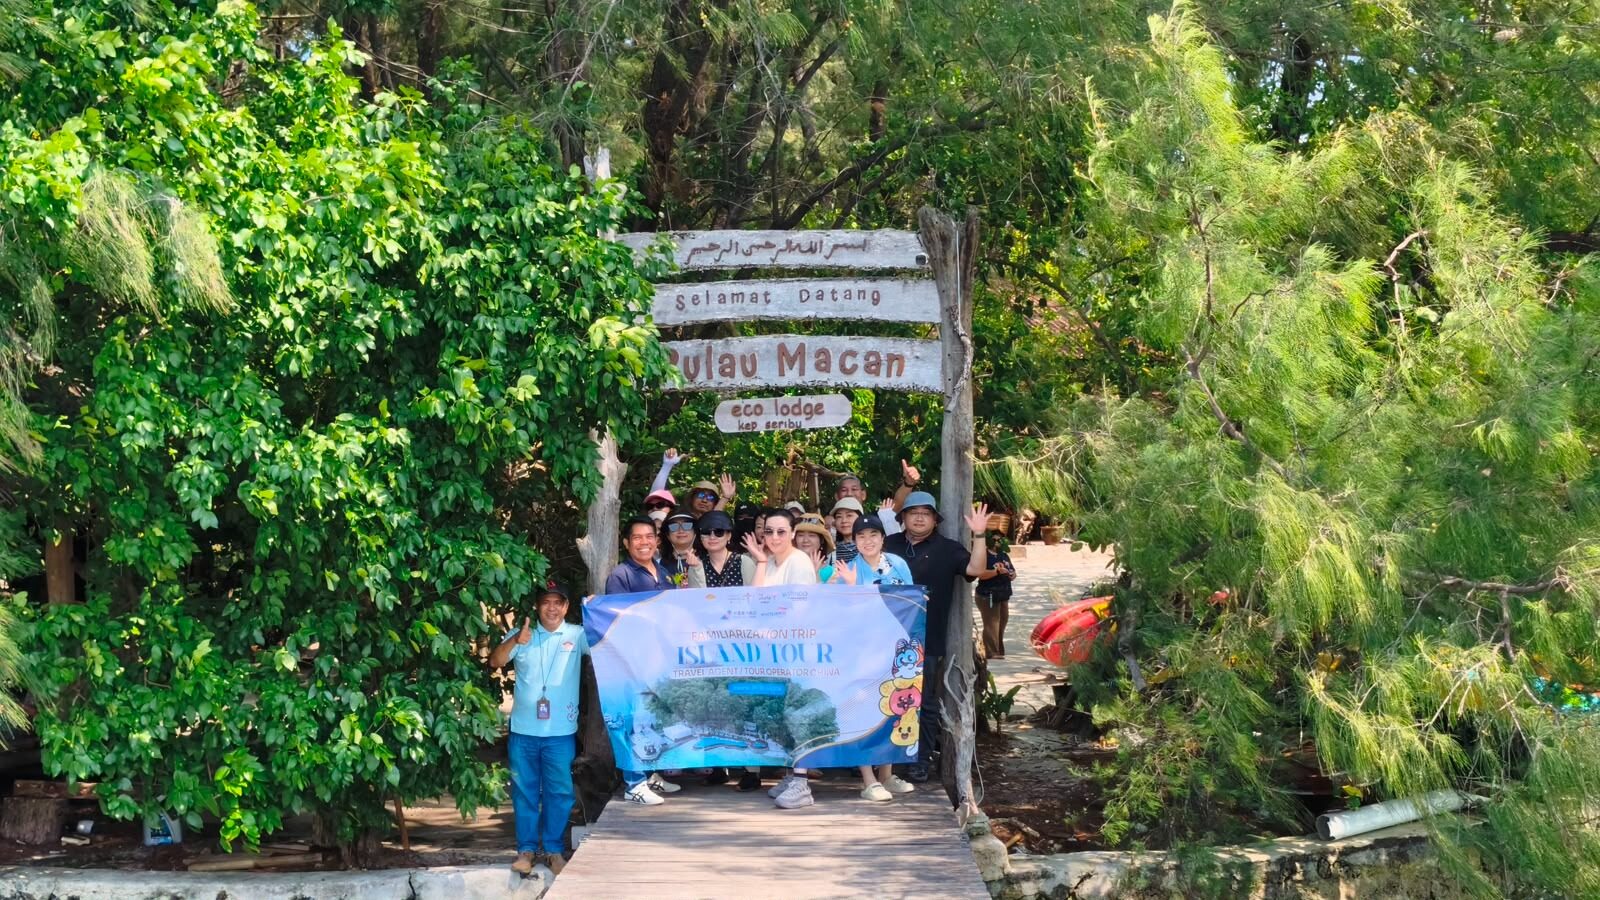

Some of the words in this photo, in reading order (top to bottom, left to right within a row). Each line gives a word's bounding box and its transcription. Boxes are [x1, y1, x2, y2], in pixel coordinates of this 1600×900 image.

[675, 289, 772, 312] Selamat
[799, 288, 880, 307] Datang
[777, 342, 906, 378] Macan
[731, 403, 764, 417] eco
[773, 398, 825, 420] lodge
[737, 420, 758, 431] kep
[765, 418, 802, 429] seribu
[691, 629, 788, 641] FAMILIARIZATION
[791, 628, 817, 640] TRIP
[676, 642, 761, 665] ISLAND
[768, 642, 833, 664] TOUR
[673, 669, 705, 678] TRAVEL
[708, 667, 739, 677] AGENT
[744, 667, 765, 675] TOUR
[766, 668, 808, 676] OPERATOR
[809, 667, 841, 677] CHINA
